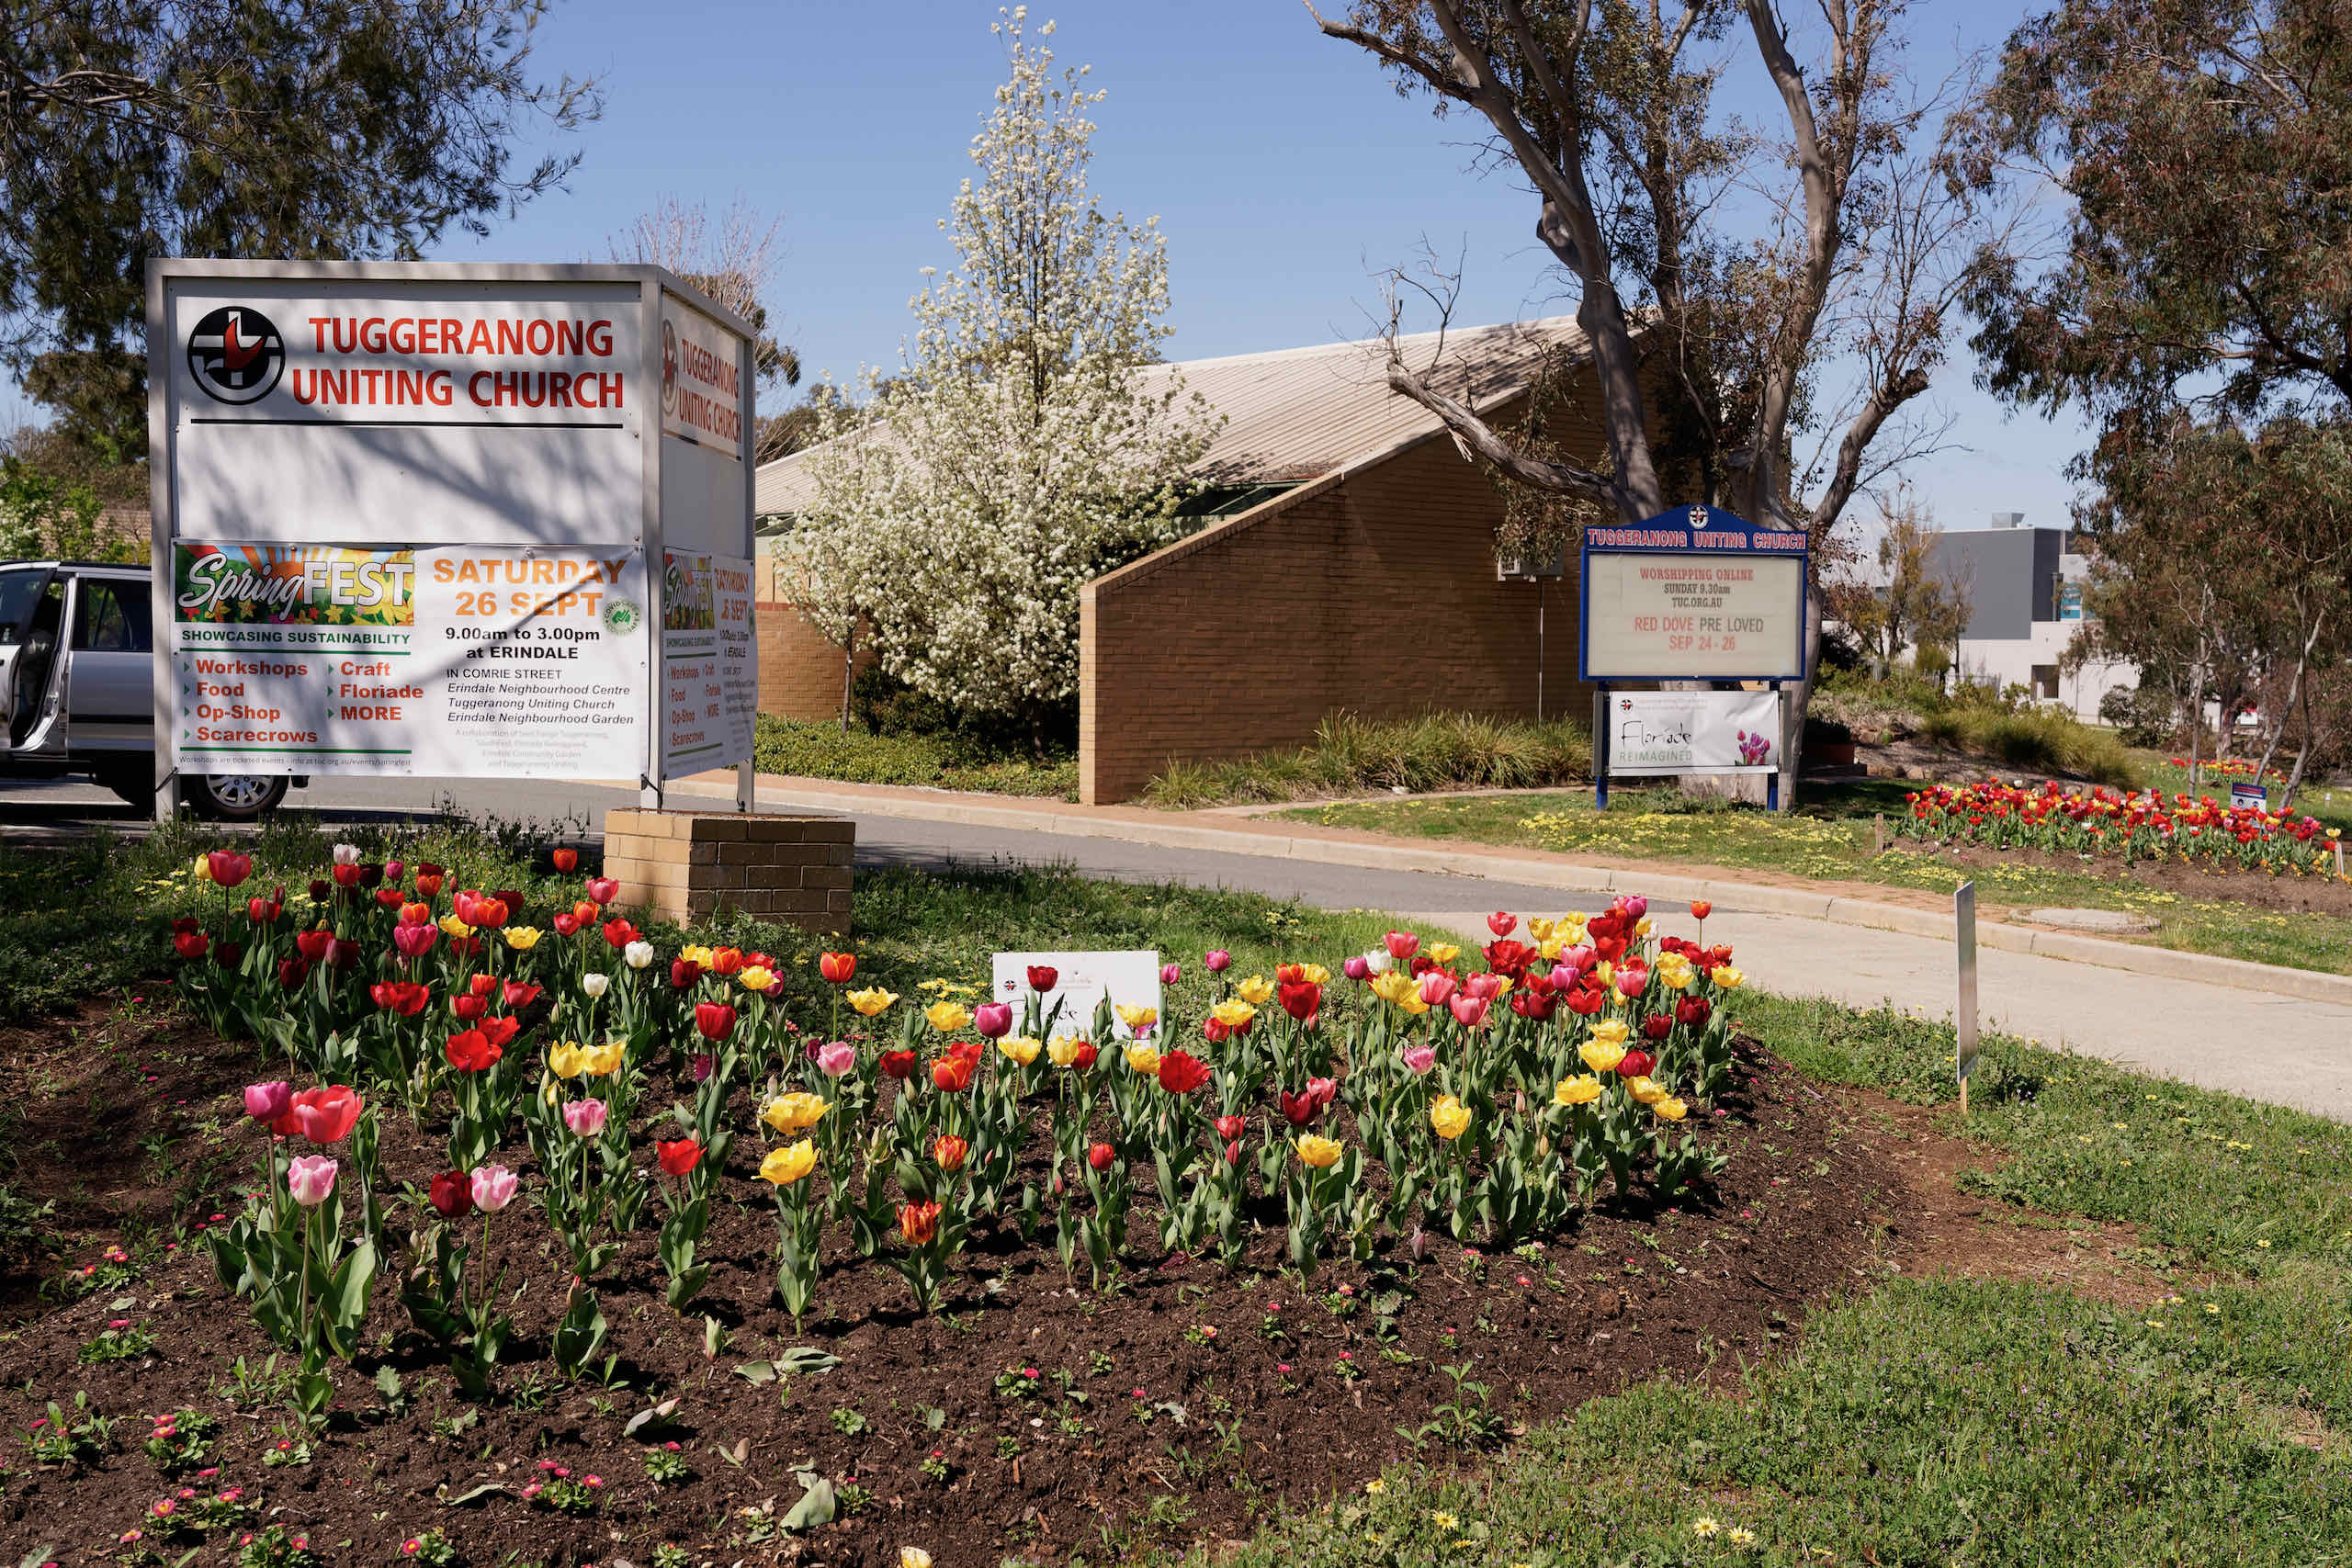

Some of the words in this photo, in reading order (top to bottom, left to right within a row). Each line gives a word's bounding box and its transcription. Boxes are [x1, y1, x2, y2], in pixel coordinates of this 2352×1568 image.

[309, 317, 613, 356] TUGGERANONG
[682, 338, 739, 400] TUGGERANONG
[293, 369, 453, 406] UNITING
[468, 370, 624, 409] CHURCH
[679, 387, 711, 433] UNITING
[714, 402, 742, 443] CHURCH
[1587, 528, 1688, 547] TUGGERANONG
[1693, 530, 1747, 548] UNITING
[1752, 533, 1806, 549] CHURCH
[433, 558, 628, 584] SATURDAY
[1639, 568, 1713, 581] WORSHIPPING
[1716, 569, 1754, 581] ONLINE
[1664, 583, 1698, 595] SUNDAY
[1700, 583, 1730, 595] 9.30am
[456, 592, 497, 616] 26
[510, 592, 603, 616] SEPT
[1671, 597, 1723, 609] TUC.ORG.AU
[1634, 616, 1657, 632] RED
[1662, 617, 1694, 632] DOVE
[1700, 617, 1722, 632] PRE
[1727, 617, 1764, 633] LOVED
[182, 630, 282, 643] SHOWCASING
[288, 632, 411, 644] SUSTAINABILITY
[446, 627, 508, 640] 9.00am
[514, 627, 531, 640] to
[537, 627, 600, 643] 3.00pm
[1668, 635, 1694, 650] SEP
[466, 647, 484, 660] at
[490, 647, 579, 660] ERINDALE
[196, 660, 308, 679] Workshops
[341, 661, 390, 676] Craft
[447, 668, 458, 678] IN
[462, 669, 510, 679] COMRIE
[514, 669, 563, 679] STREET
[197, 682, 244, 697] Food
[340, 683, 424, 699] Floriade
[447, 683, 495, 694] Erindale
[499, 683, 588, 696] Neighbourhood
[592, 684, 630, 695] Centre
[671, 688, 685, 703] Food
[448, 698, 525, 710] Tuggeranong
[528, 698, 570, 710] Uniting
[572, 699, 615, 709] Church
[197, 705, 280, 723] Op-Shop
[341, 706, 402, 721] MORE
[447, 712, 495, 723] Erindale
[499, 713, 589, 725] Neighbourhood
[591, 714, 634, 725] Garden
[198, 727, 318, 743] Scarecrows
[1620, 750, 1692, 762] REIMAGINED
